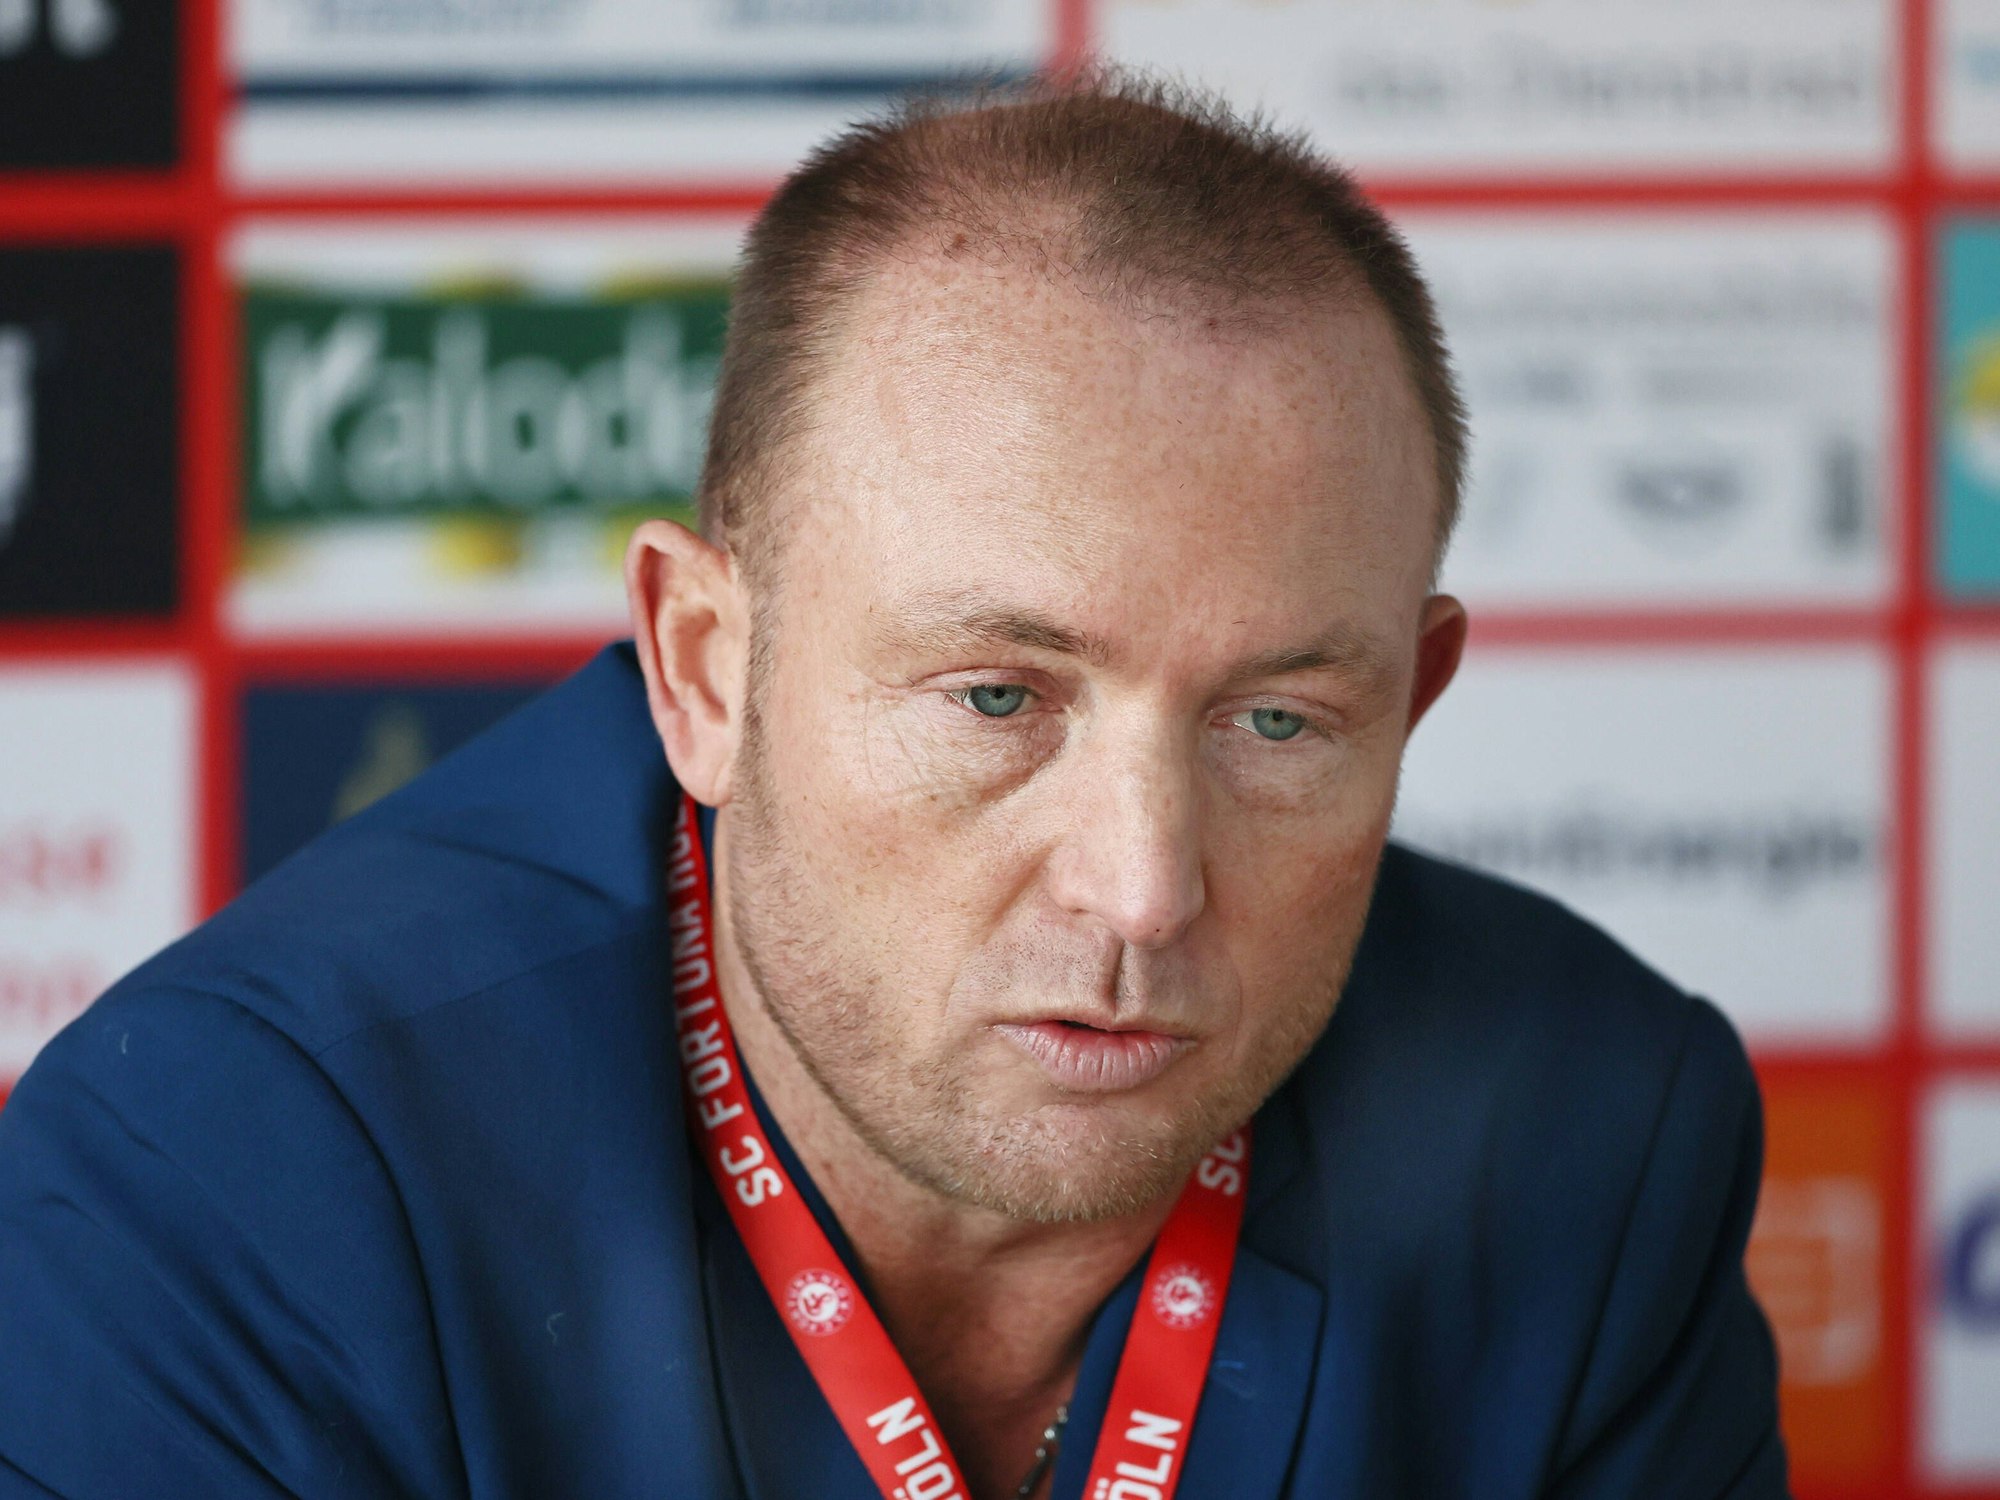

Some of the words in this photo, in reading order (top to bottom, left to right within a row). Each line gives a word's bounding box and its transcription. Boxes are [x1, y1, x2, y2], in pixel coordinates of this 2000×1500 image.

[670, 899, 744, 1130] FORTUNA
[720, 1134, 783, 1208] SC
[866, 1396, 963, 1500] ÖLN
[1093, 1409, 1183, 1500] ÖLN
